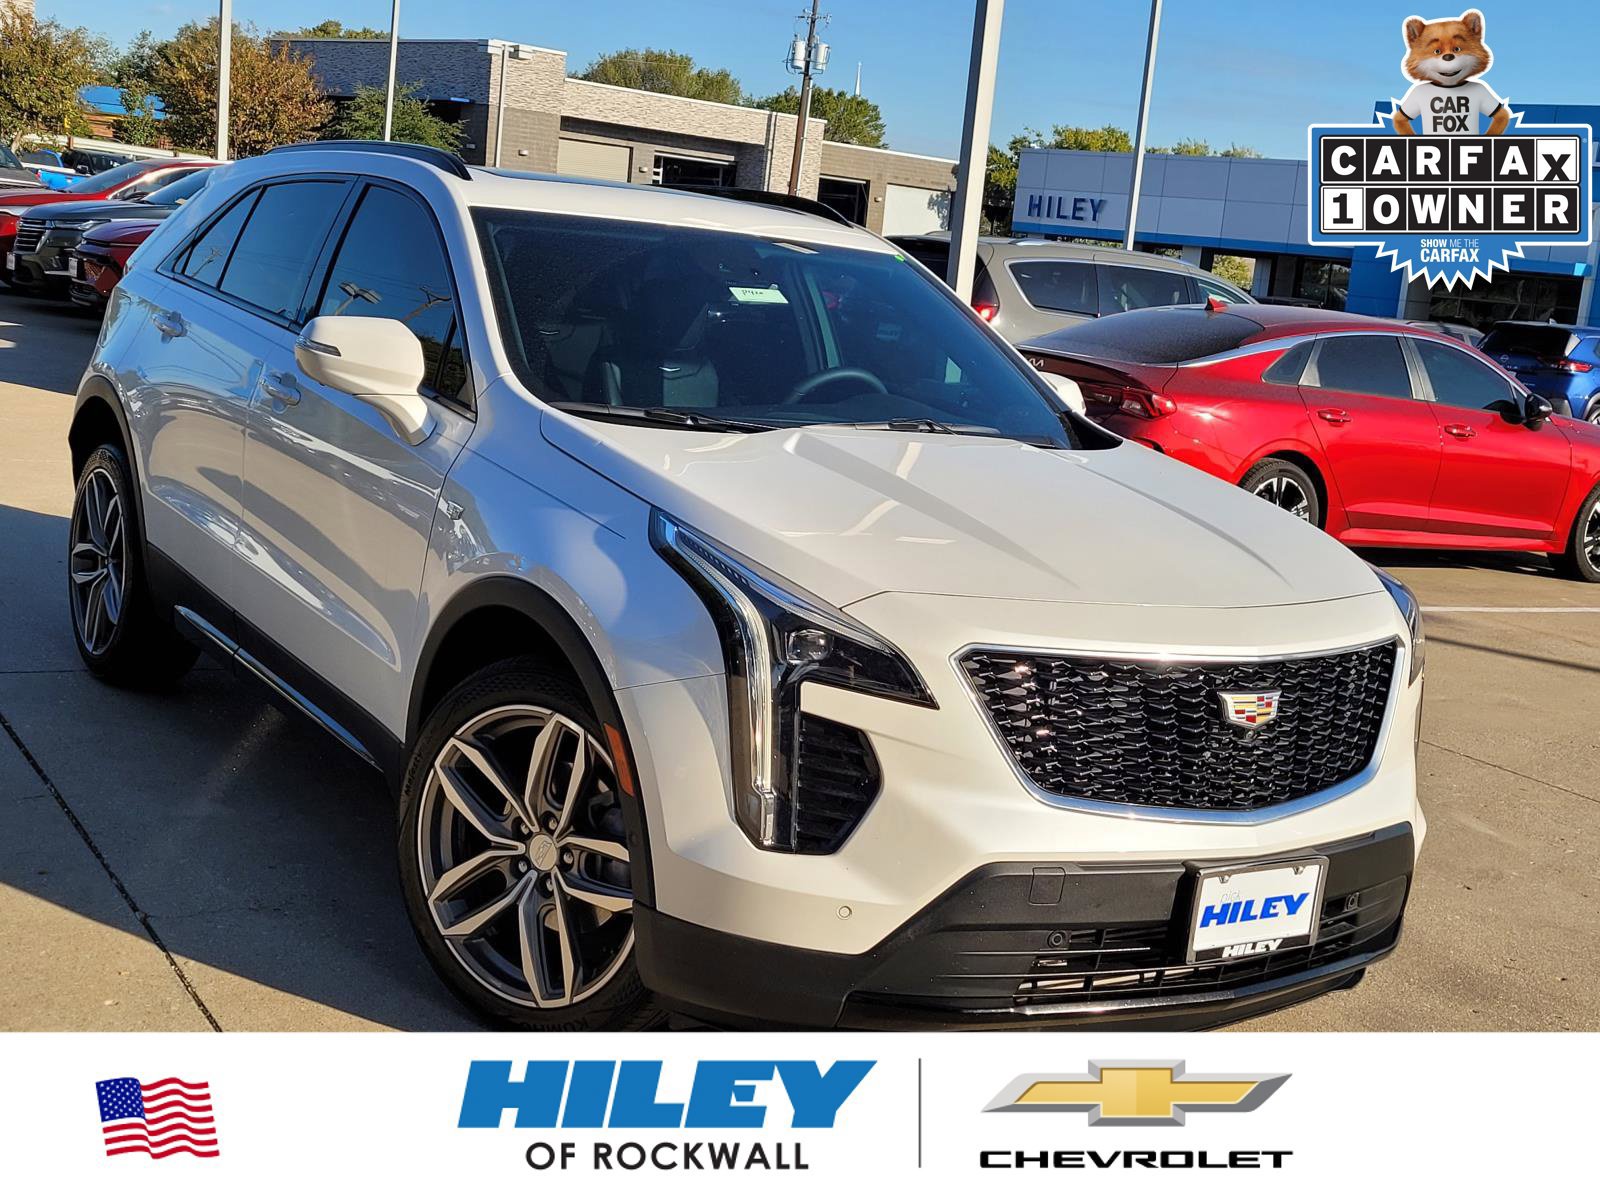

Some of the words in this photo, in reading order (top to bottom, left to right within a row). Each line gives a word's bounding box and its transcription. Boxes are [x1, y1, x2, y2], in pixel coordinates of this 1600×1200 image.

[1027, 194, 1107, 222] HILEY
[1199, 892, 1310, 929] HILEY
[1222, 938, 1283, 958] HILEY
